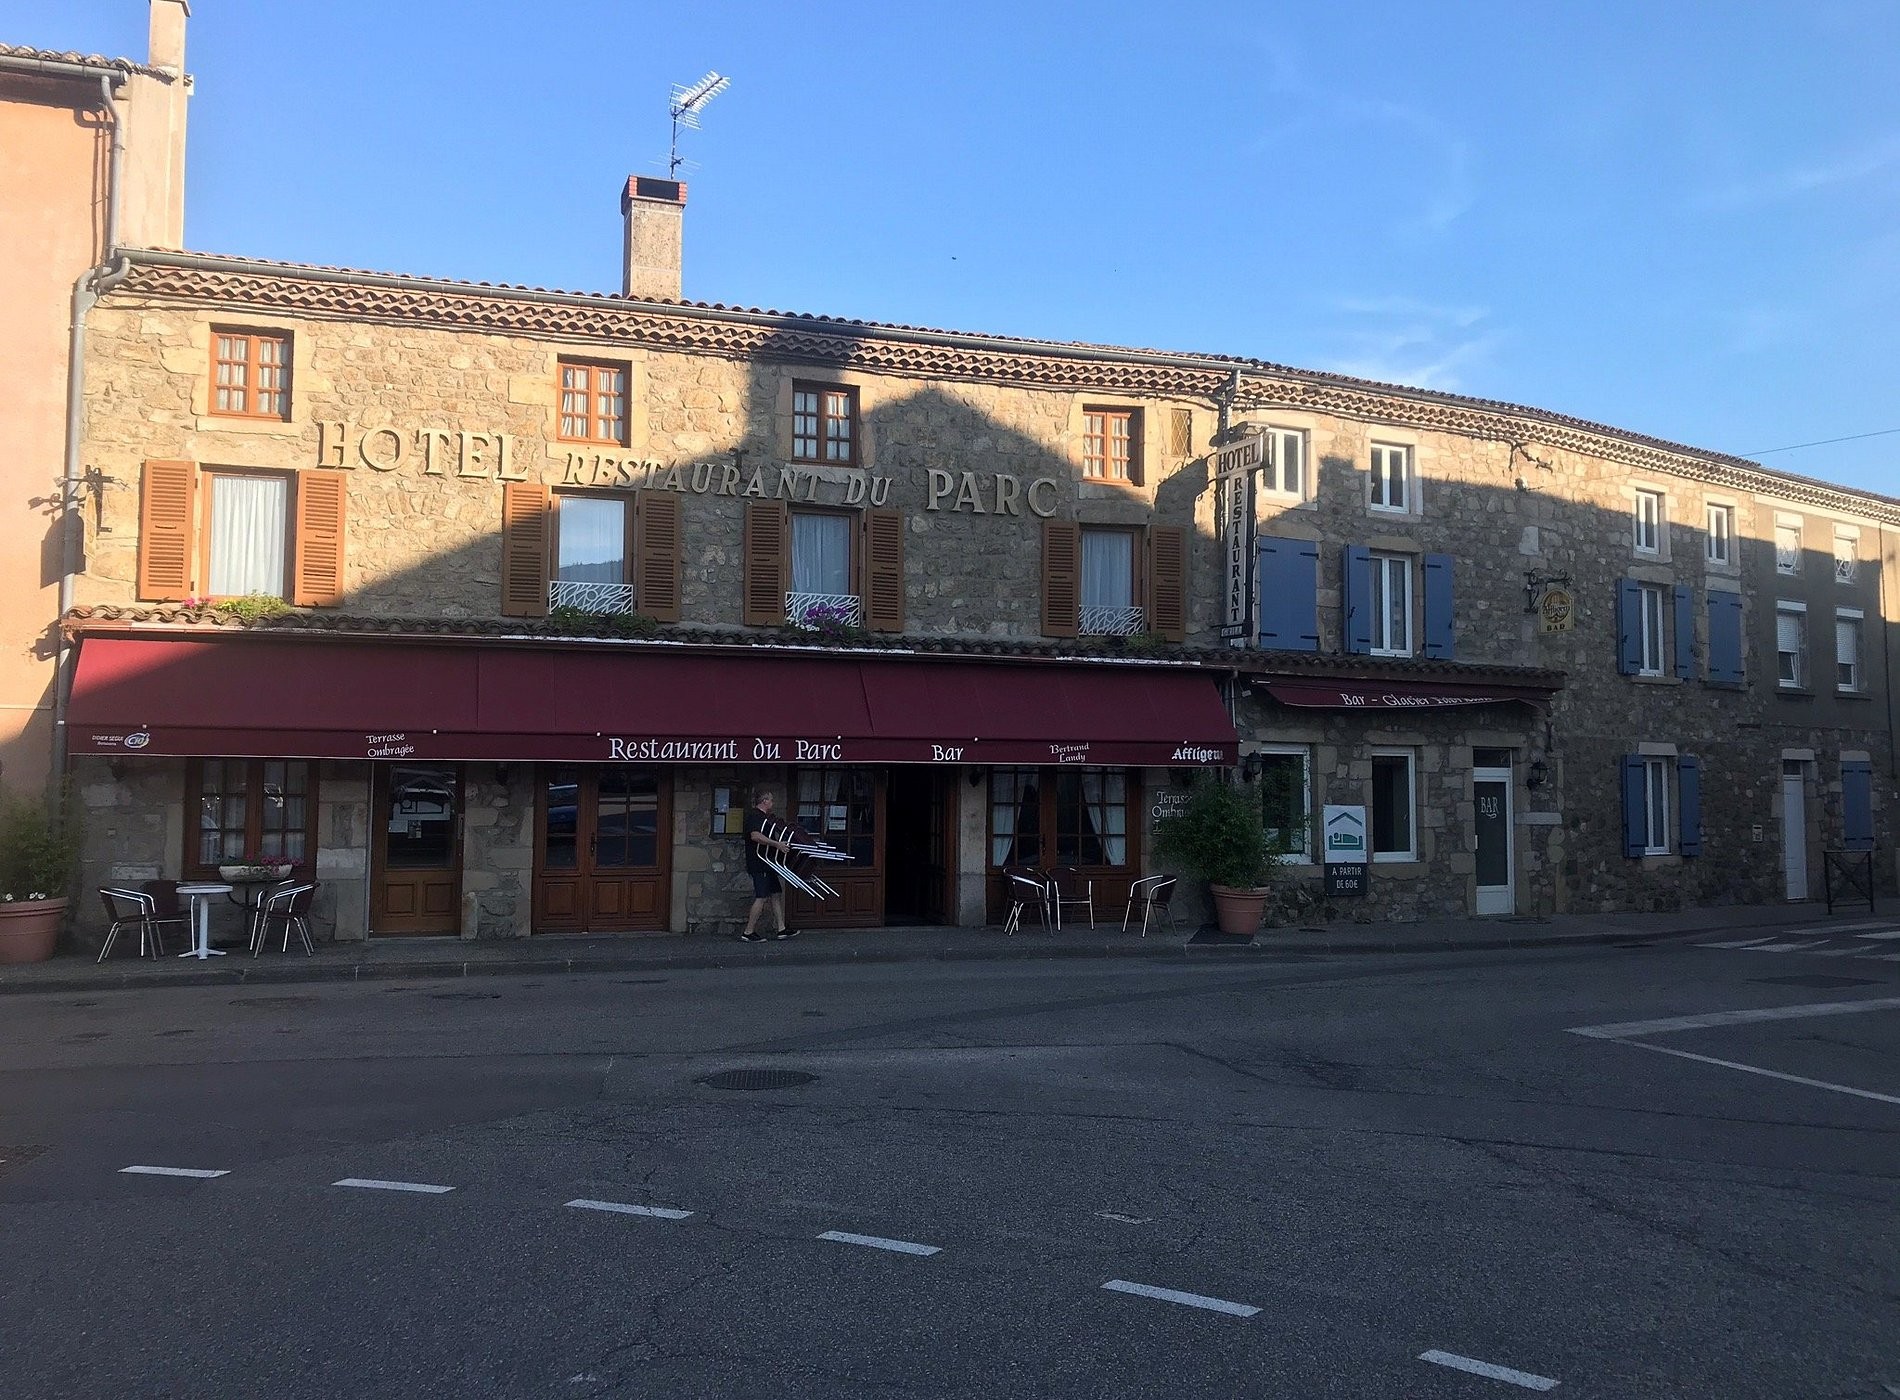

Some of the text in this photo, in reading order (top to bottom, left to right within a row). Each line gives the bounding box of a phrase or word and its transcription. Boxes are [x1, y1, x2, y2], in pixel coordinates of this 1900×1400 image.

[1218, 442, 1258, 474] HOTEL
[317, 419, 1061, 518] HOTEL RESTAURANT DU PARC
[1229, 477, 1243, 622] RESTAURANT
[1546, 624, 1565, 632] BAR
[1340, 693, 1365, 706] Bar
[1382, 693, 1430, 706] Glacier
[365, 733, 406, 744] Terrasse
[367, 743, 415, 758] Ombragée
[608, 737, 842, 760] Restaurant du Parc
[931, 744, 964, 761] Bar
[1049, 742, 1090, 754] Bertrand
[1059, 753, 1086, 763] Landy
[1480, 796, 1499, 814] BAR
[1331, 866, 1362, 876] A PARTIR
[1336, 879, 1359, 889] DE 60€
